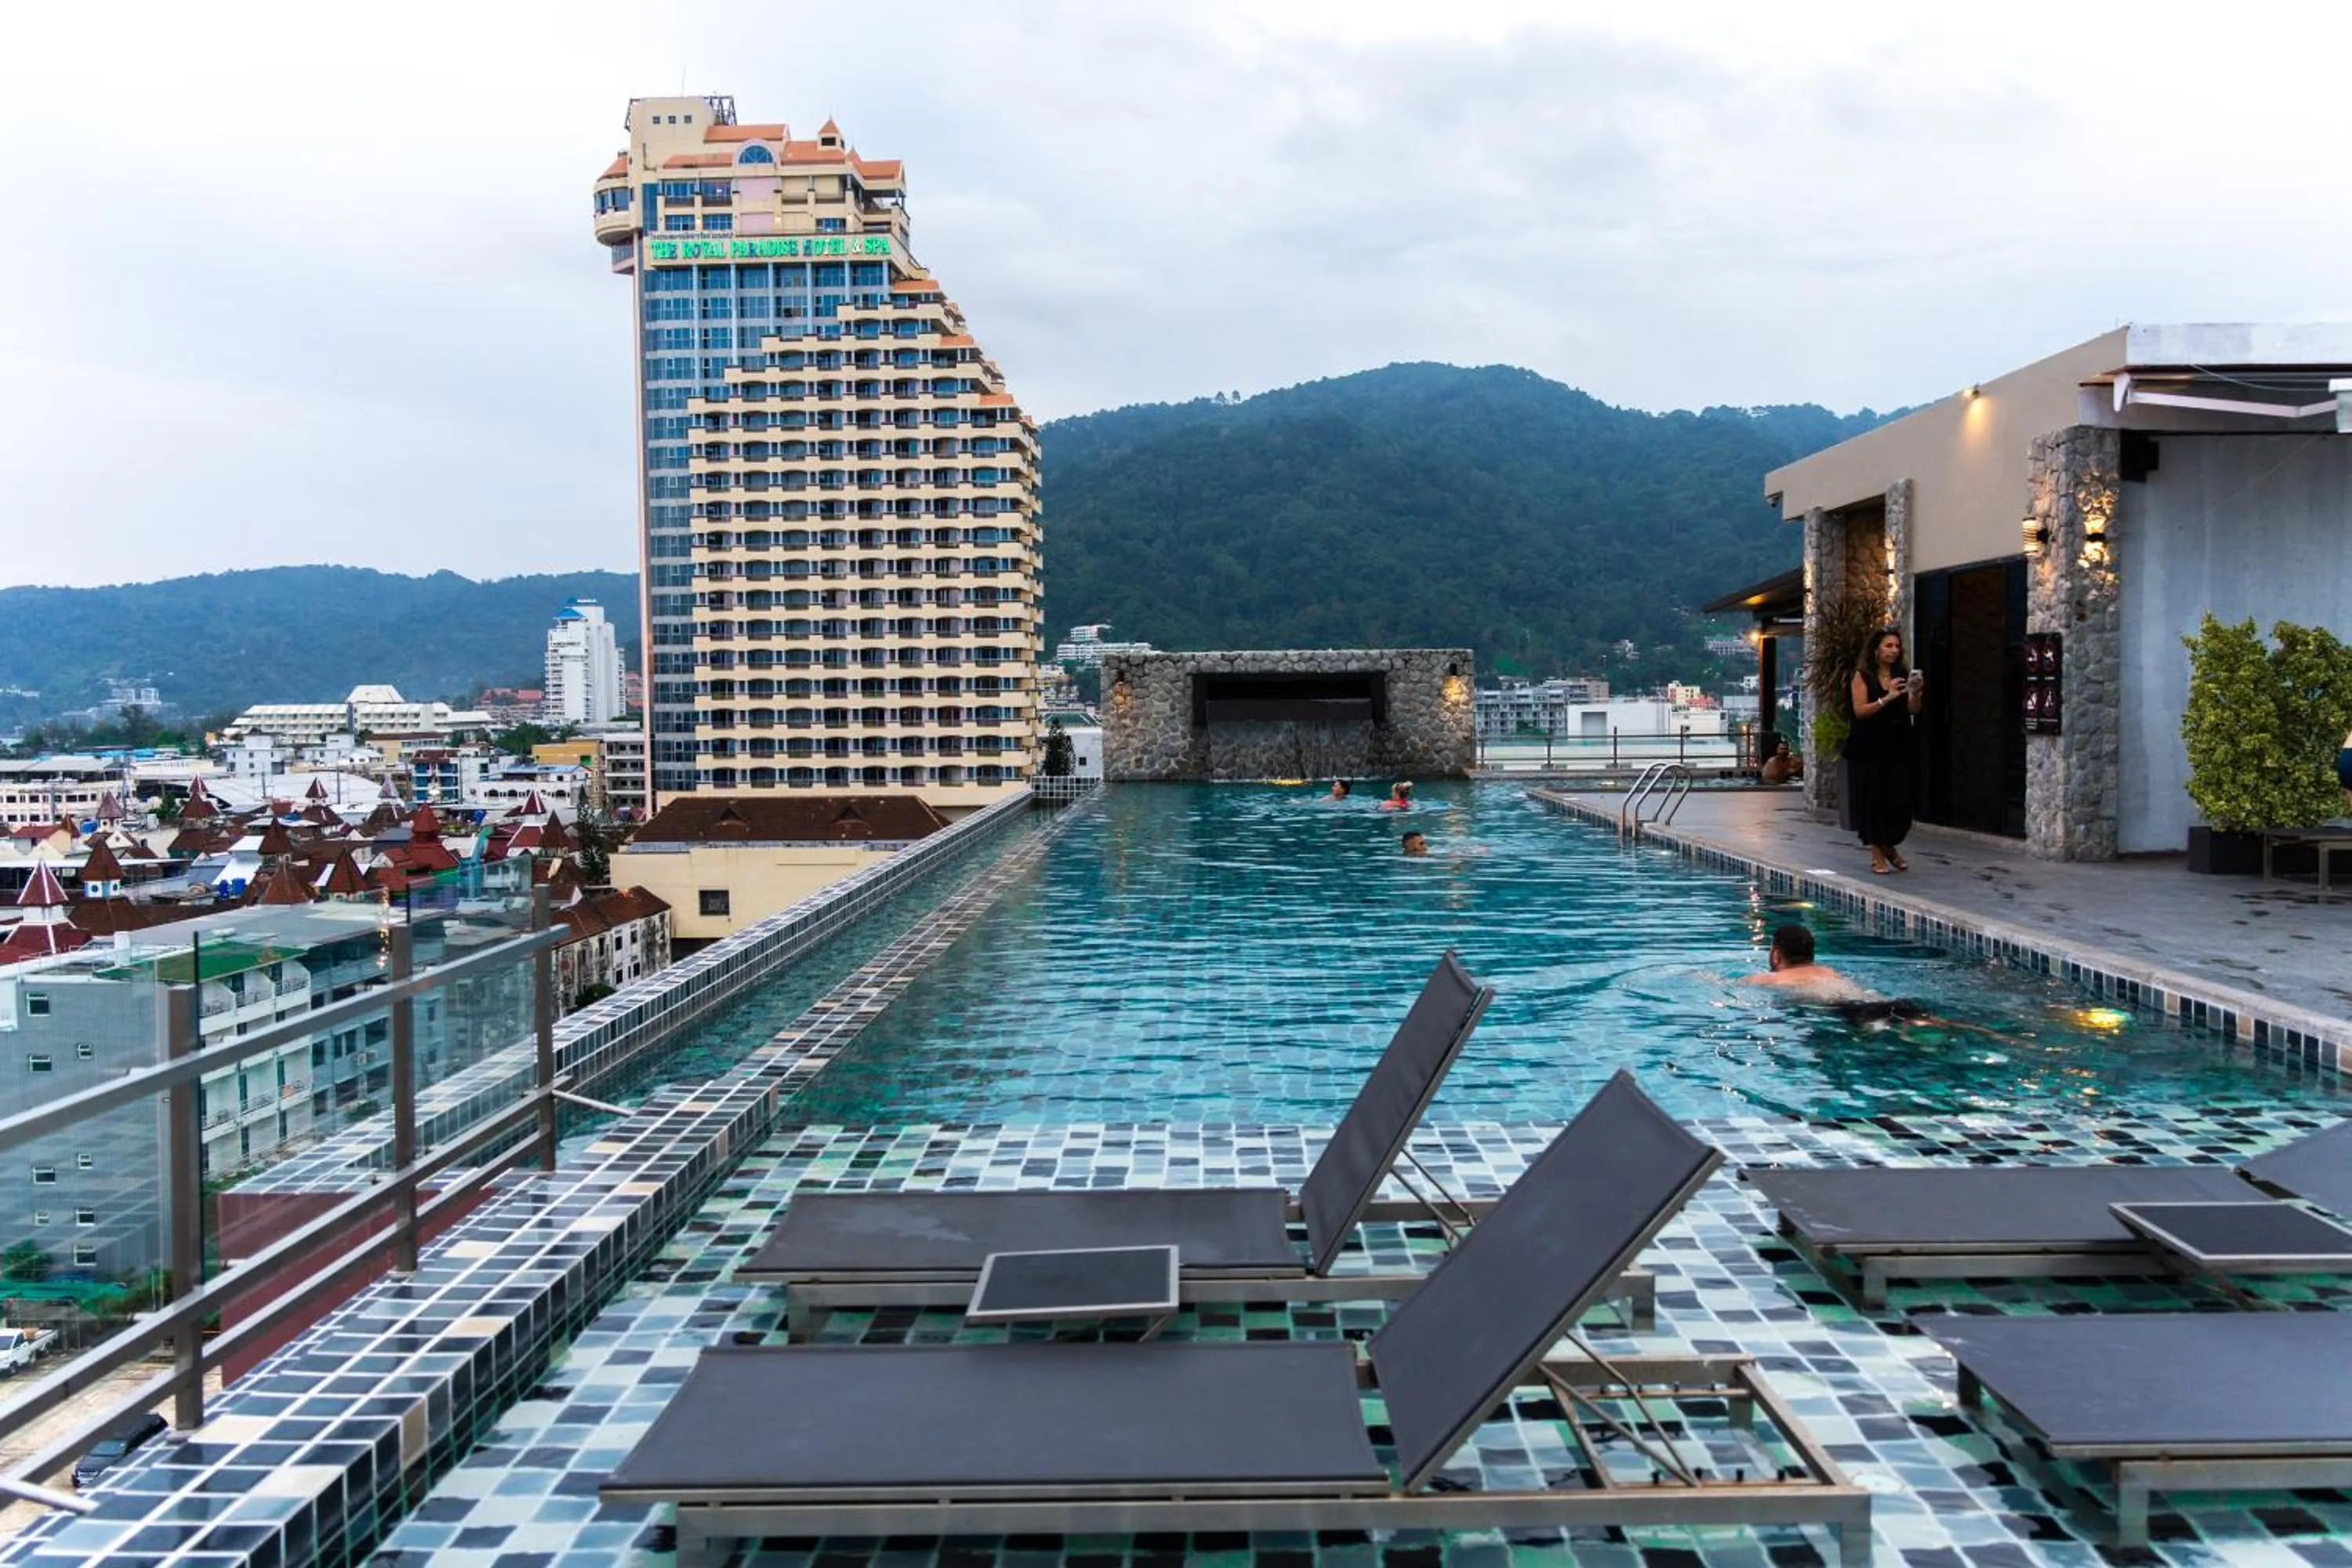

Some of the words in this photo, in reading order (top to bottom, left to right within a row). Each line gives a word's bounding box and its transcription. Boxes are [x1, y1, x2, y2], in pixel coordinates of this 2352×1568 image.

[652, 240, 677, 260] THE
[682, 240, 726, 259] ROYAL
[730, 238, 797, 258] PARADISE
[802, 238, 848, 256] HOTEL
[852, 238, 862, 254] &
[865, 237, 891, 255] SPA
